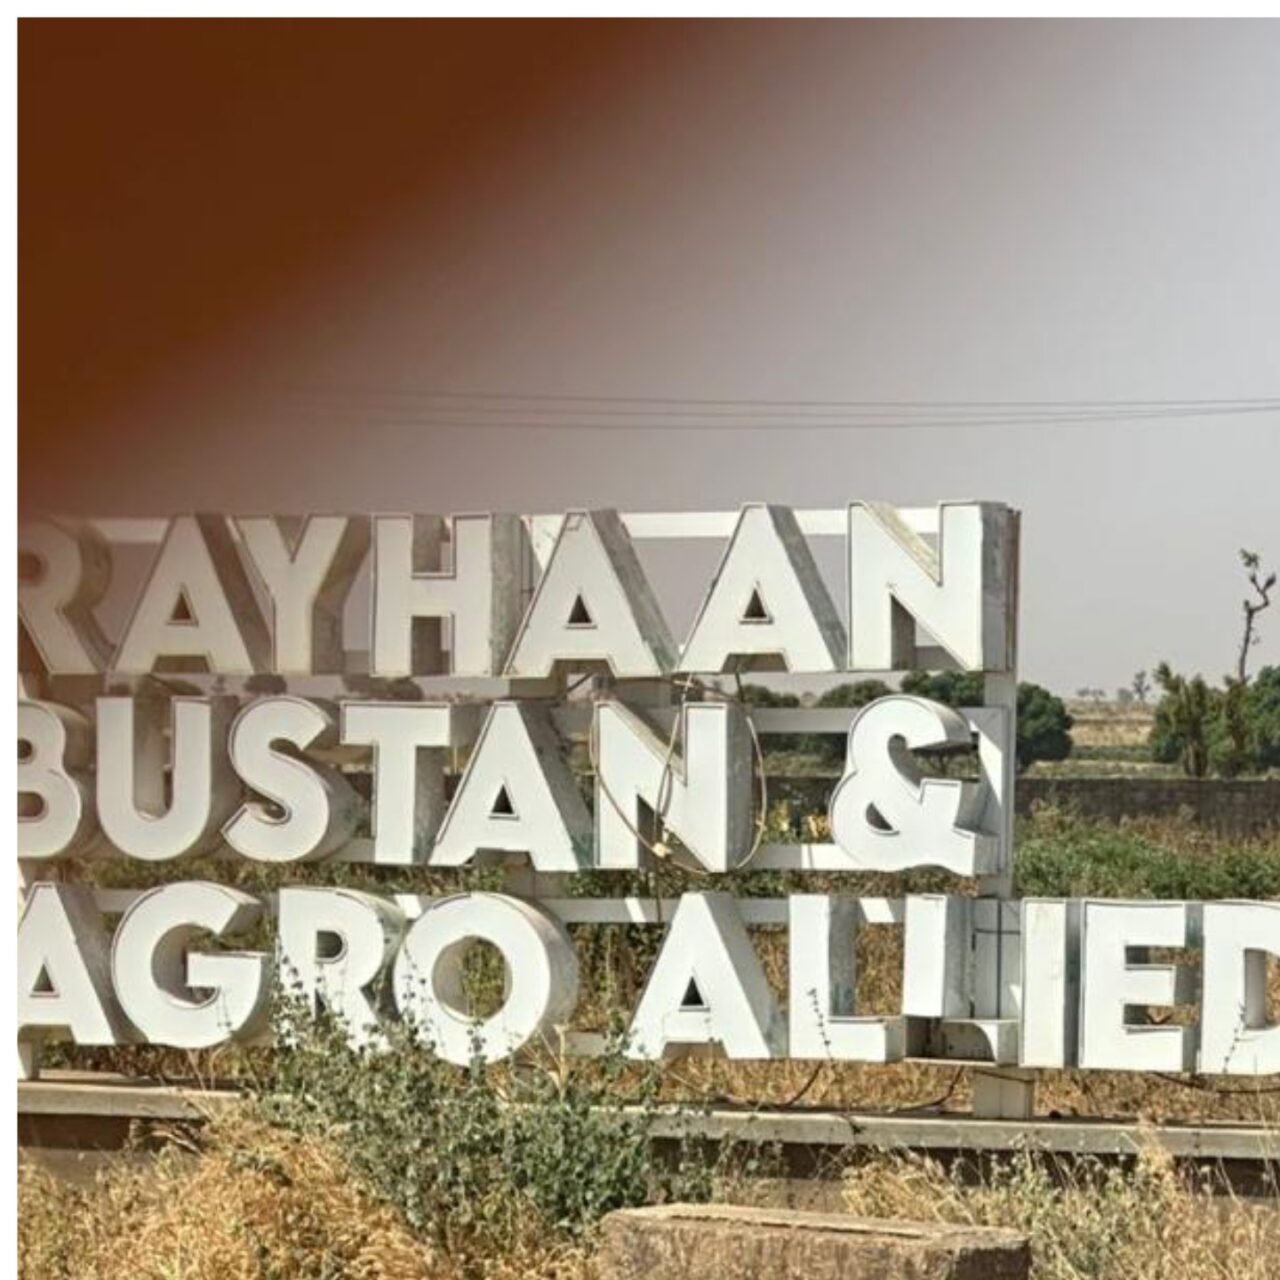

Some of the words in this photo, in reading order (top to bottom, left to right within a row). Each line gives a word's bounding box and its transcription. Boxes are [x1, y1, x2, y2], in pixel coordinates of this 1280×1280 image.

[17, 502, 1015, 676] RAYHAAN
[17, 696, 735, 872] BUSTAN
[830, 696, 980, 876] &
[17, 880, 570, 1066] AGRO
